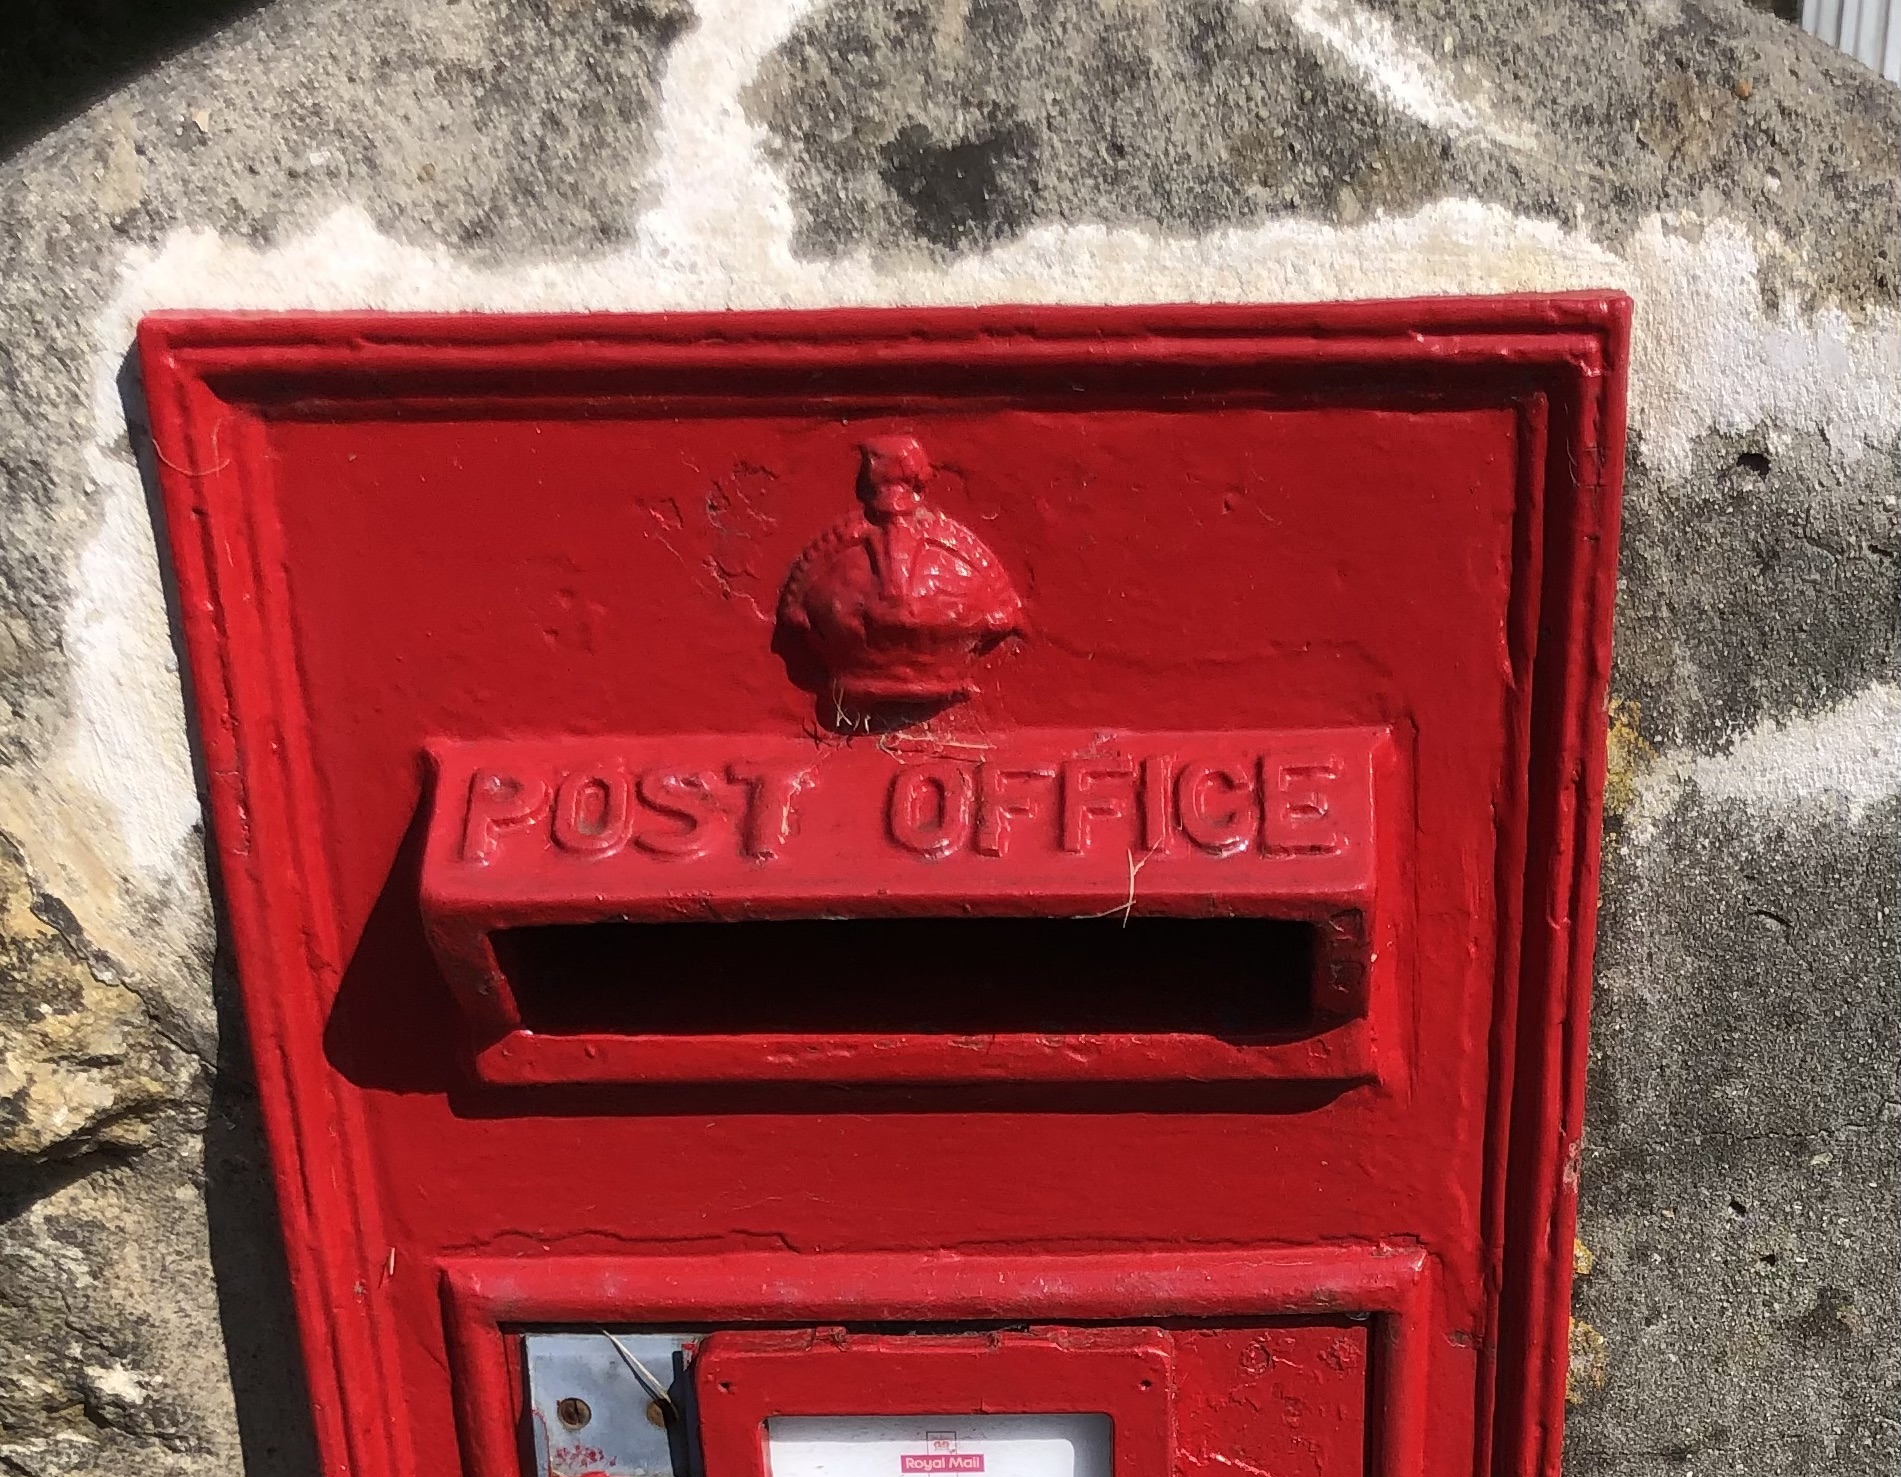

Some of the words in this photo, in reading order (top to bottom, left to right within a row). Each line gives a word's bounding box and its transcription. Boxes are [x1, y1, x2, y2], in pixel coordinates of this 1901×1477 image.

[457, 762, 814, 869] POST
[886, 751, 1350, 861] OFFICE
[906, 1458, 945, 1471] Royal
[949, 1457, 979, 1468] Mail
